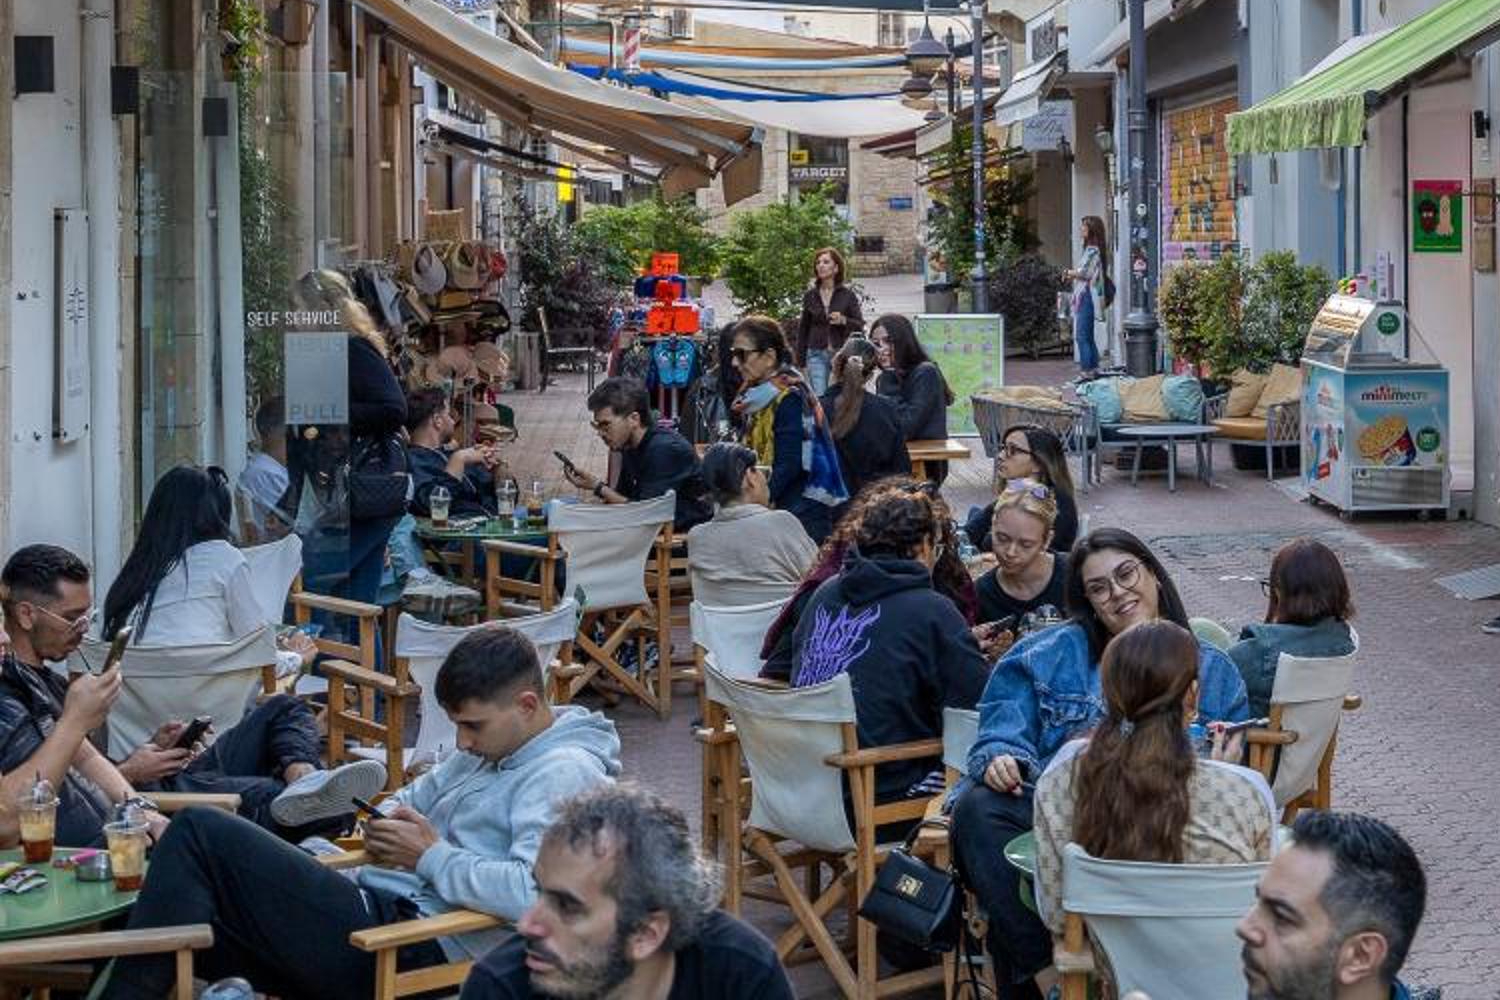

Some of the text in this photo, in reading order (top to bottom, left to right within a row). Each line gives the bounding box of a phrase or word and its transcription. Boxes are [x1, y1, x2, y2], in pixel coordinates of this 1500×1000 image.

[791, 167, 847, 178] TARGET
[247, 310, 342, 327] SELF SERVICE
